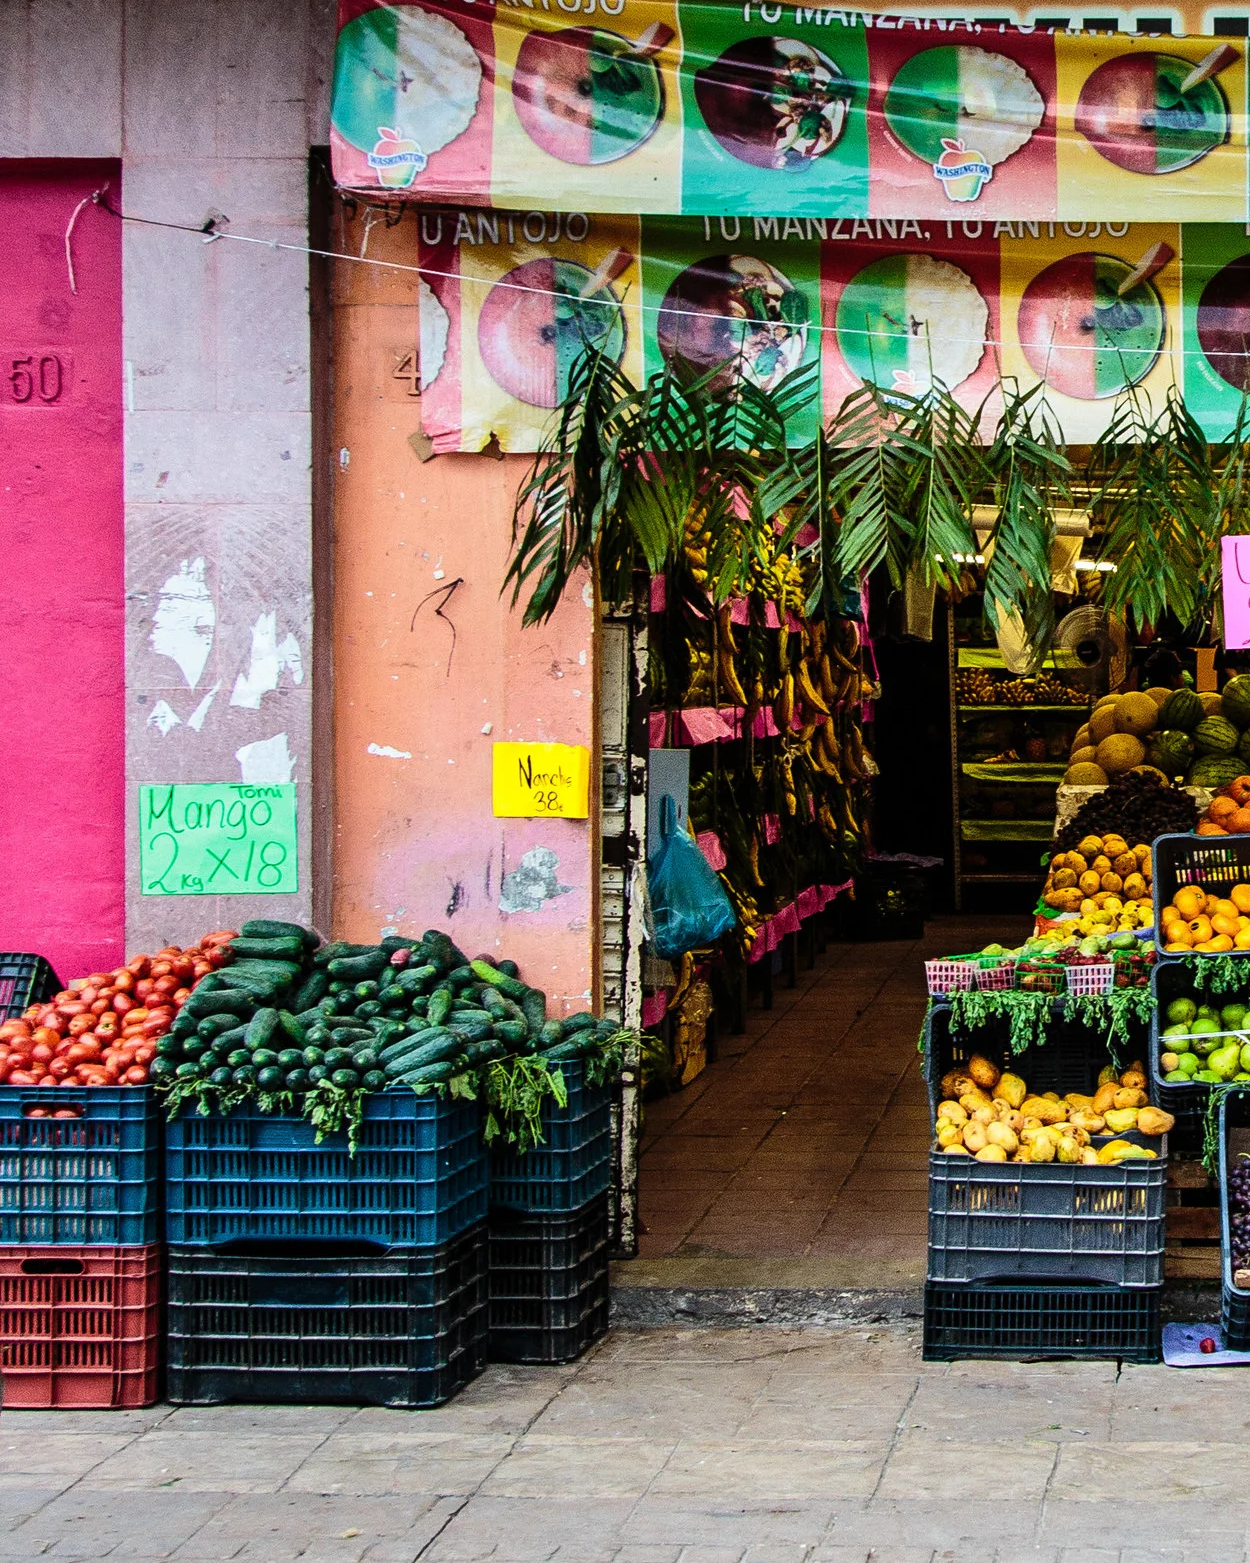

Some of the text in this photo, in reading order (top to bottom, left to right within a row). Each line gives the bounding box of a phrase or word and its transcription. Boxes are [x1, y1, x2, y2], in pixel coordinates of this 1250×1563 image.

[936, 163, 990, 178] WASHINGTON
[453, 211, 589, 245] ANTOJO
[753, 217, 931, 242] MANZANA,
[9, 353, 63, 402] 50
[148, 785, 273, 840] Mango
